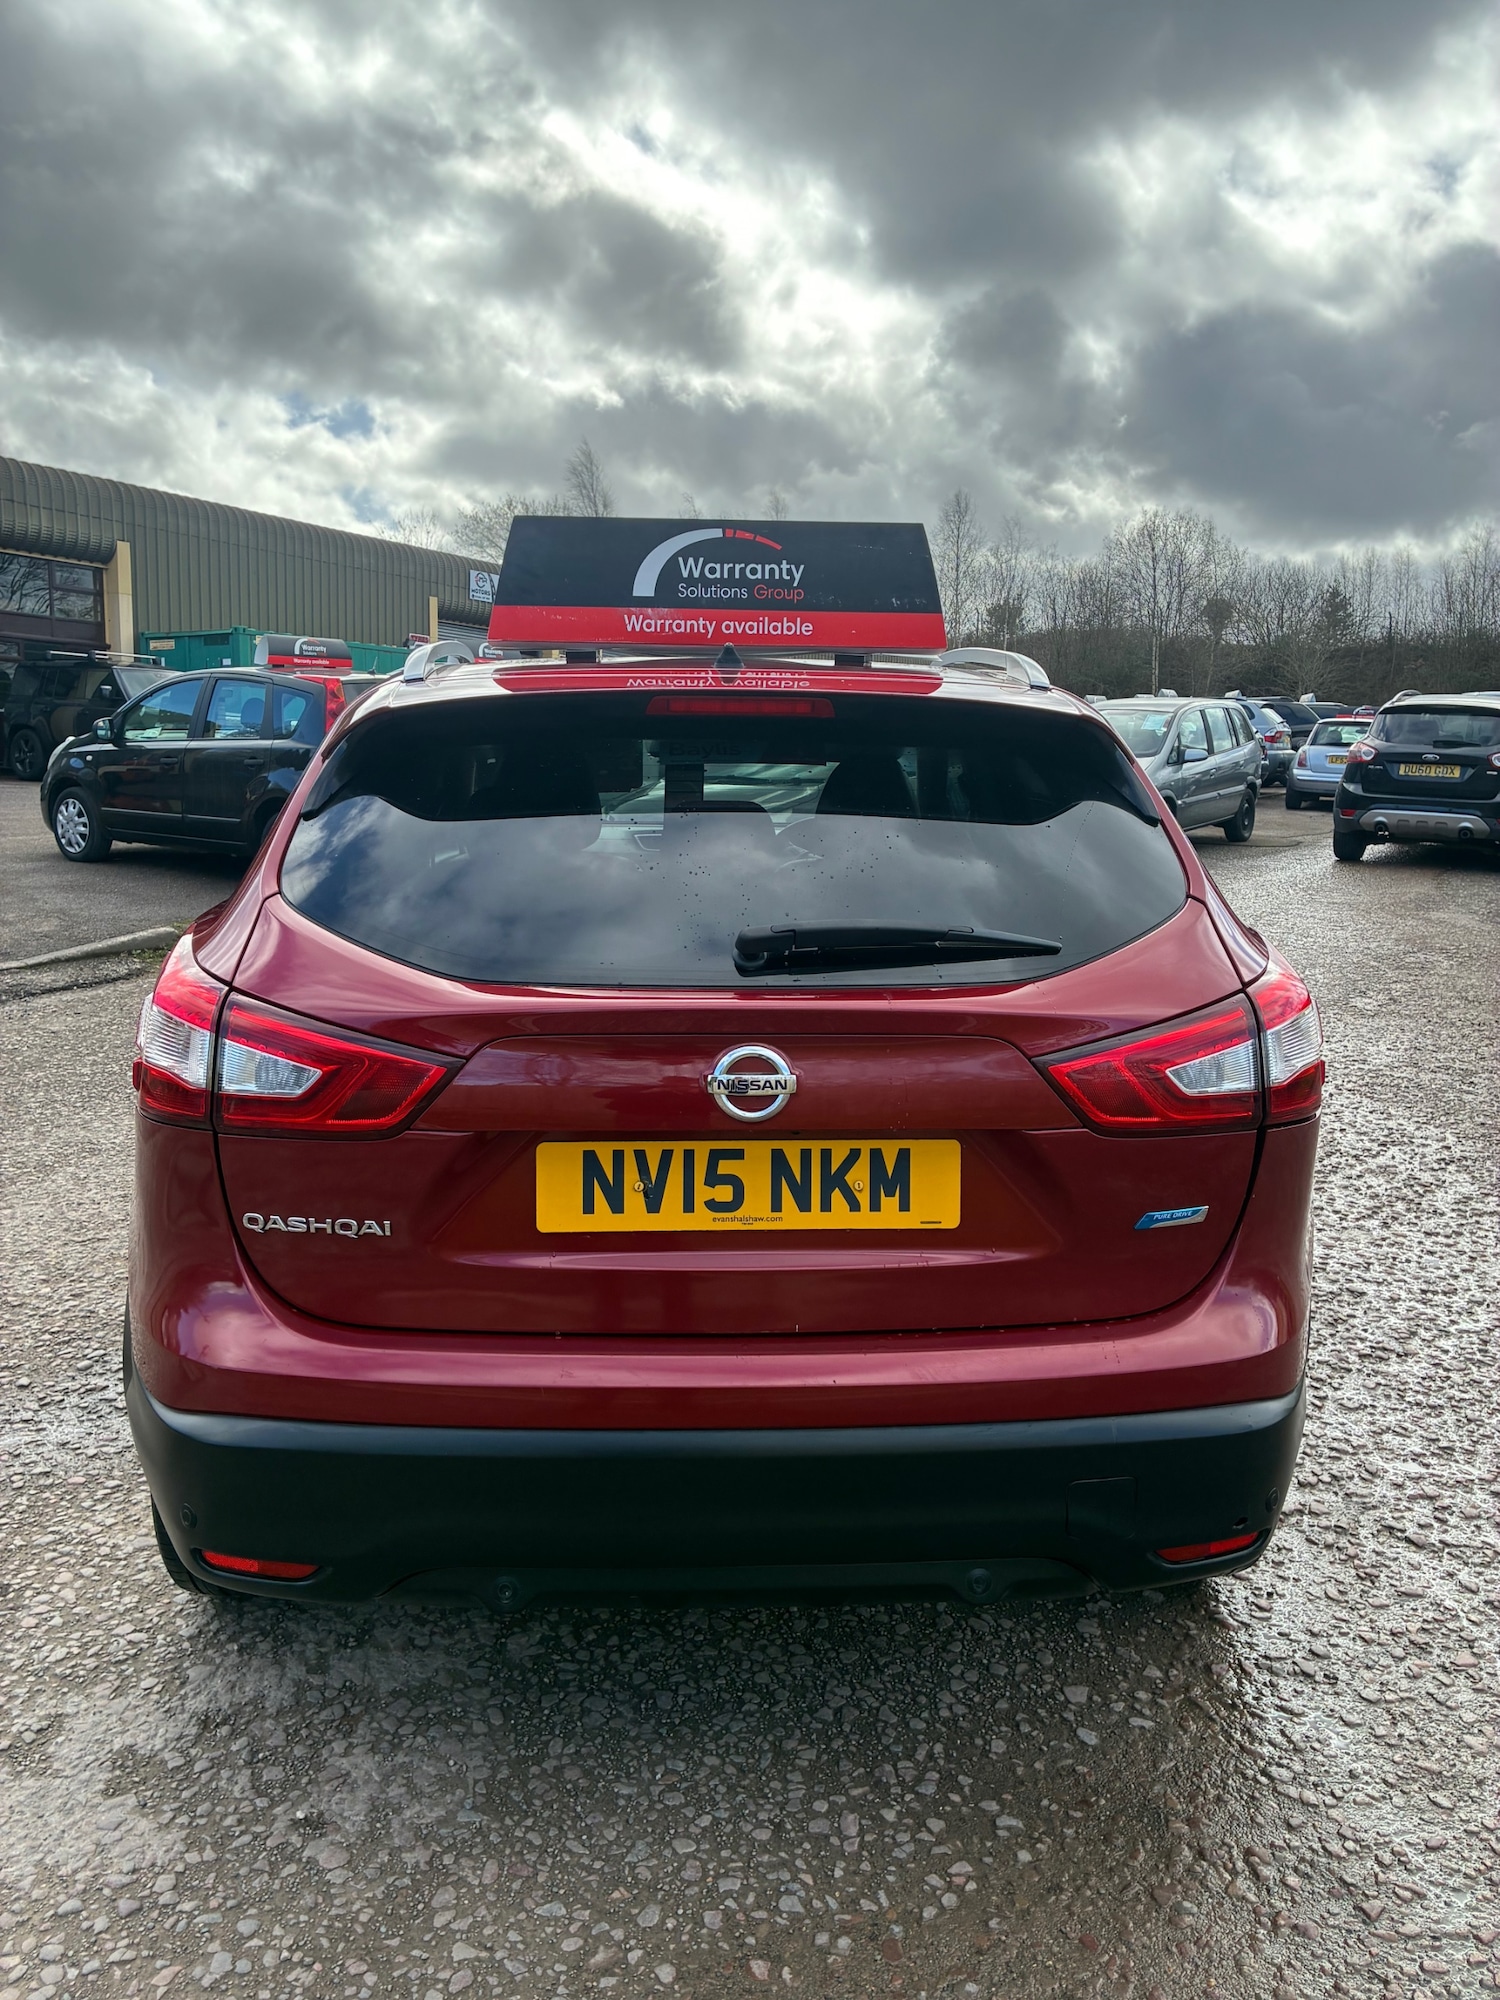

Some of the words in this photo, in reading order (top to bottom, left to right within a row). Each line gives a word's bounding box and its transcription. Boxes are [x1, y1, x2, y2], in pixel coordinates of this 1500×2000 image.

[677, 556, 804, 587] Warranty
[471, 588, 491, 597] MOTORS
[677, 583, 748, 599] Solutions
[753, 584, 805, 603] Group
[624, 614, 716, 639] Warranty
[721, 616, 814, 636] available
[301, 644, 327, 654] Warranty
[669, 742, 742, 759] Baylis
[717, 1079, 787, 1092] NISSAN
[582, 1148, 745, 1214] NV15
[770, 1148, 911, 1212] NKM
[712, 1215, 783, 1223] evanshalshaw.com
